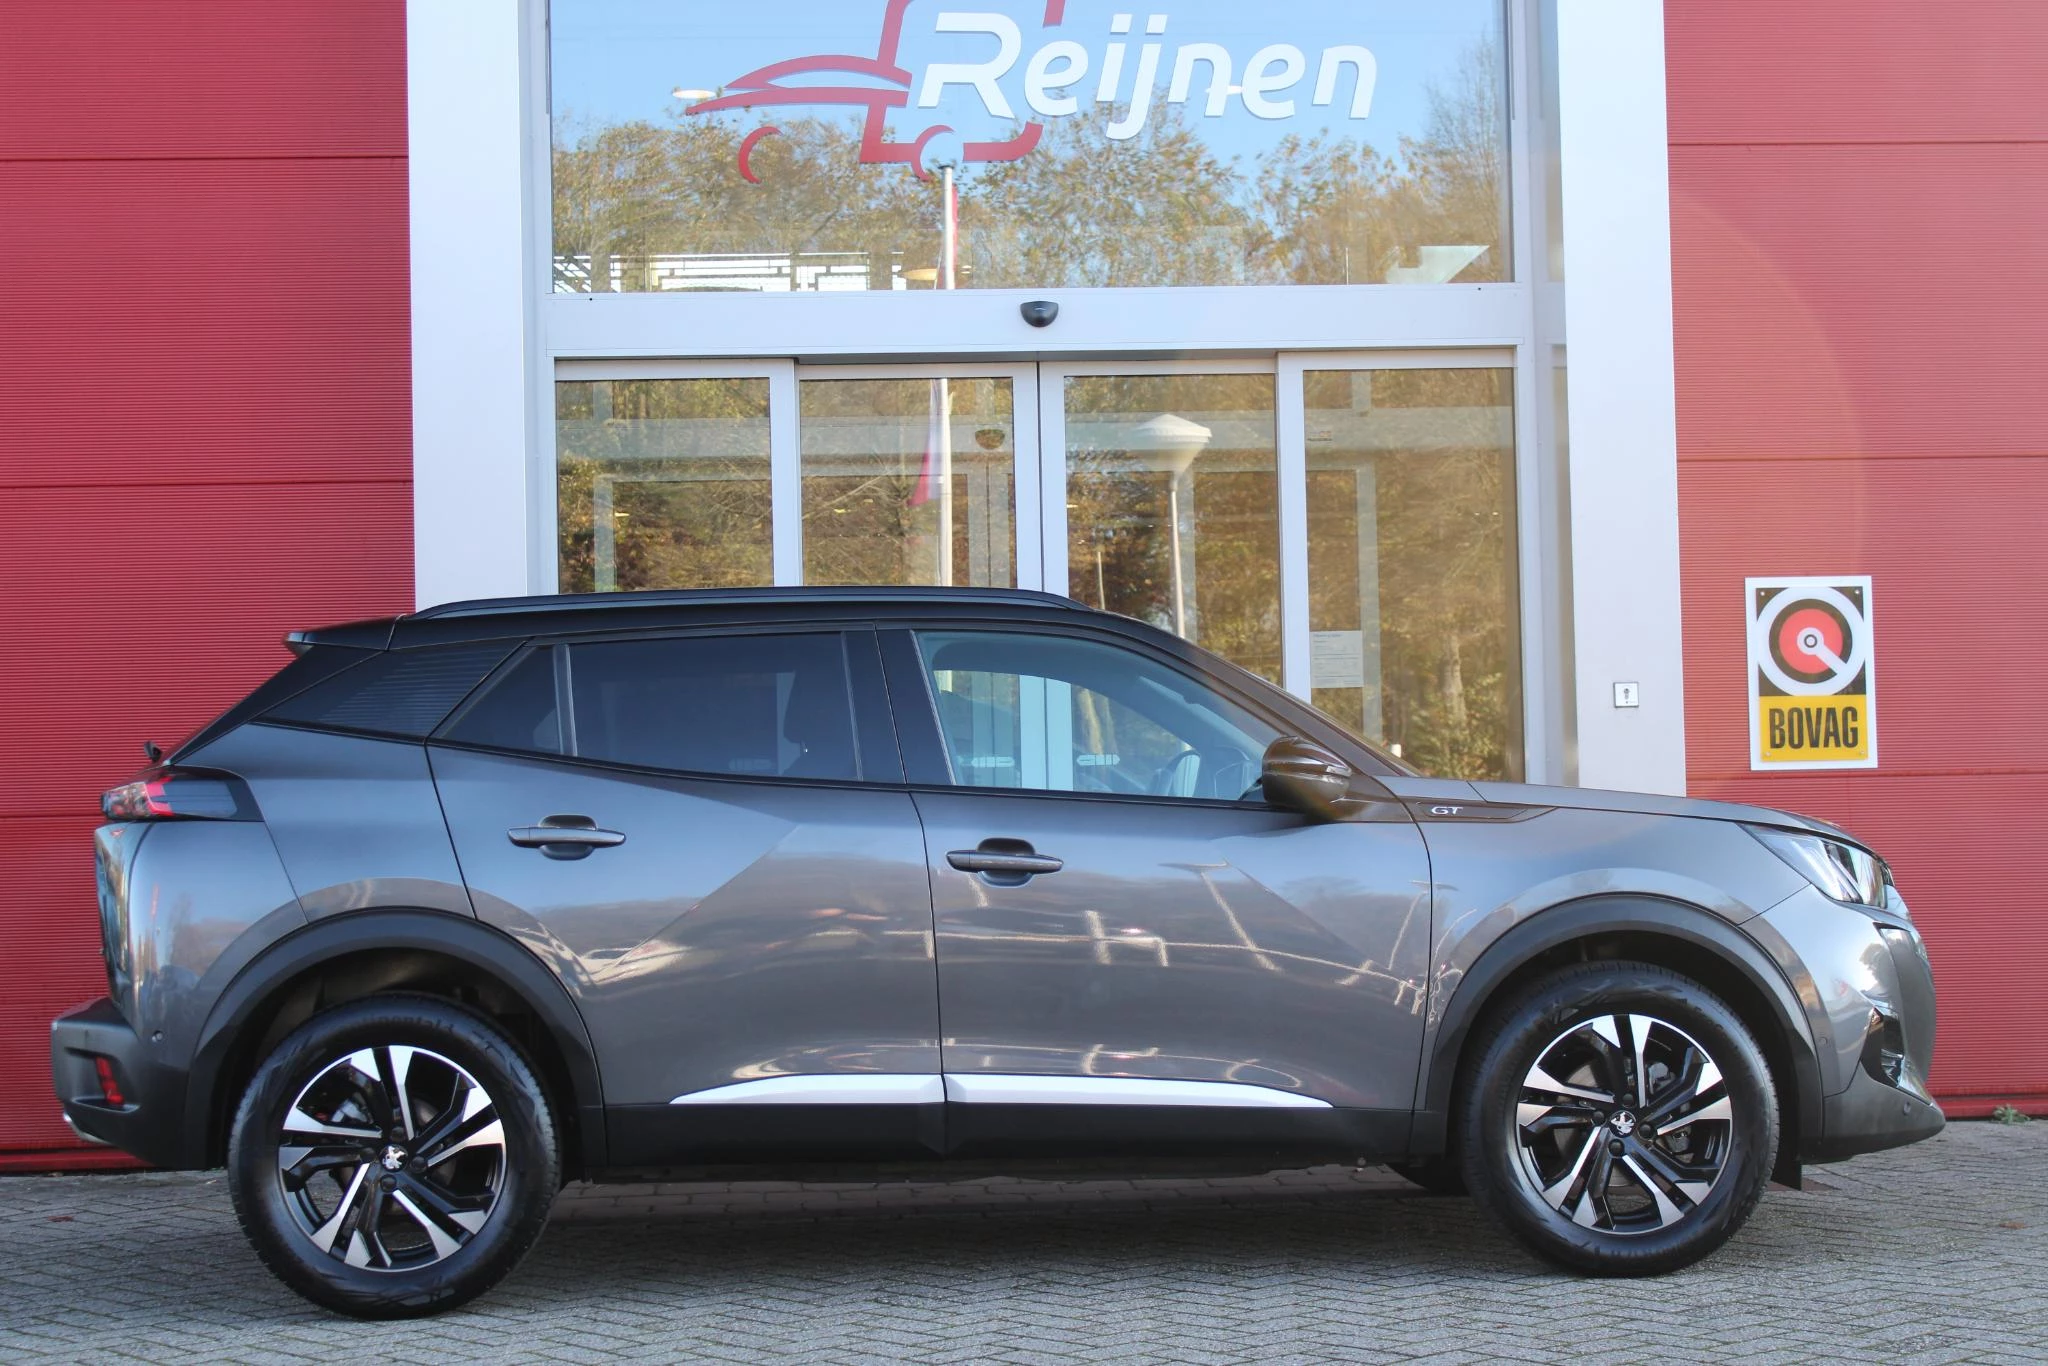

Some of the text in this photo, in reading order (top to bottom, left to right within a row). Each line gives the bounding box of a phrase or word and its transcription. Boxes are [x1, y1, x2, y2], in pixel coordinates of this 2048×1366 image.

[918, 13, 1377, 140] Reijnen
[1769, 706, 1858, 749] BOVAG
[1431, 806, 1463, 815] GT
